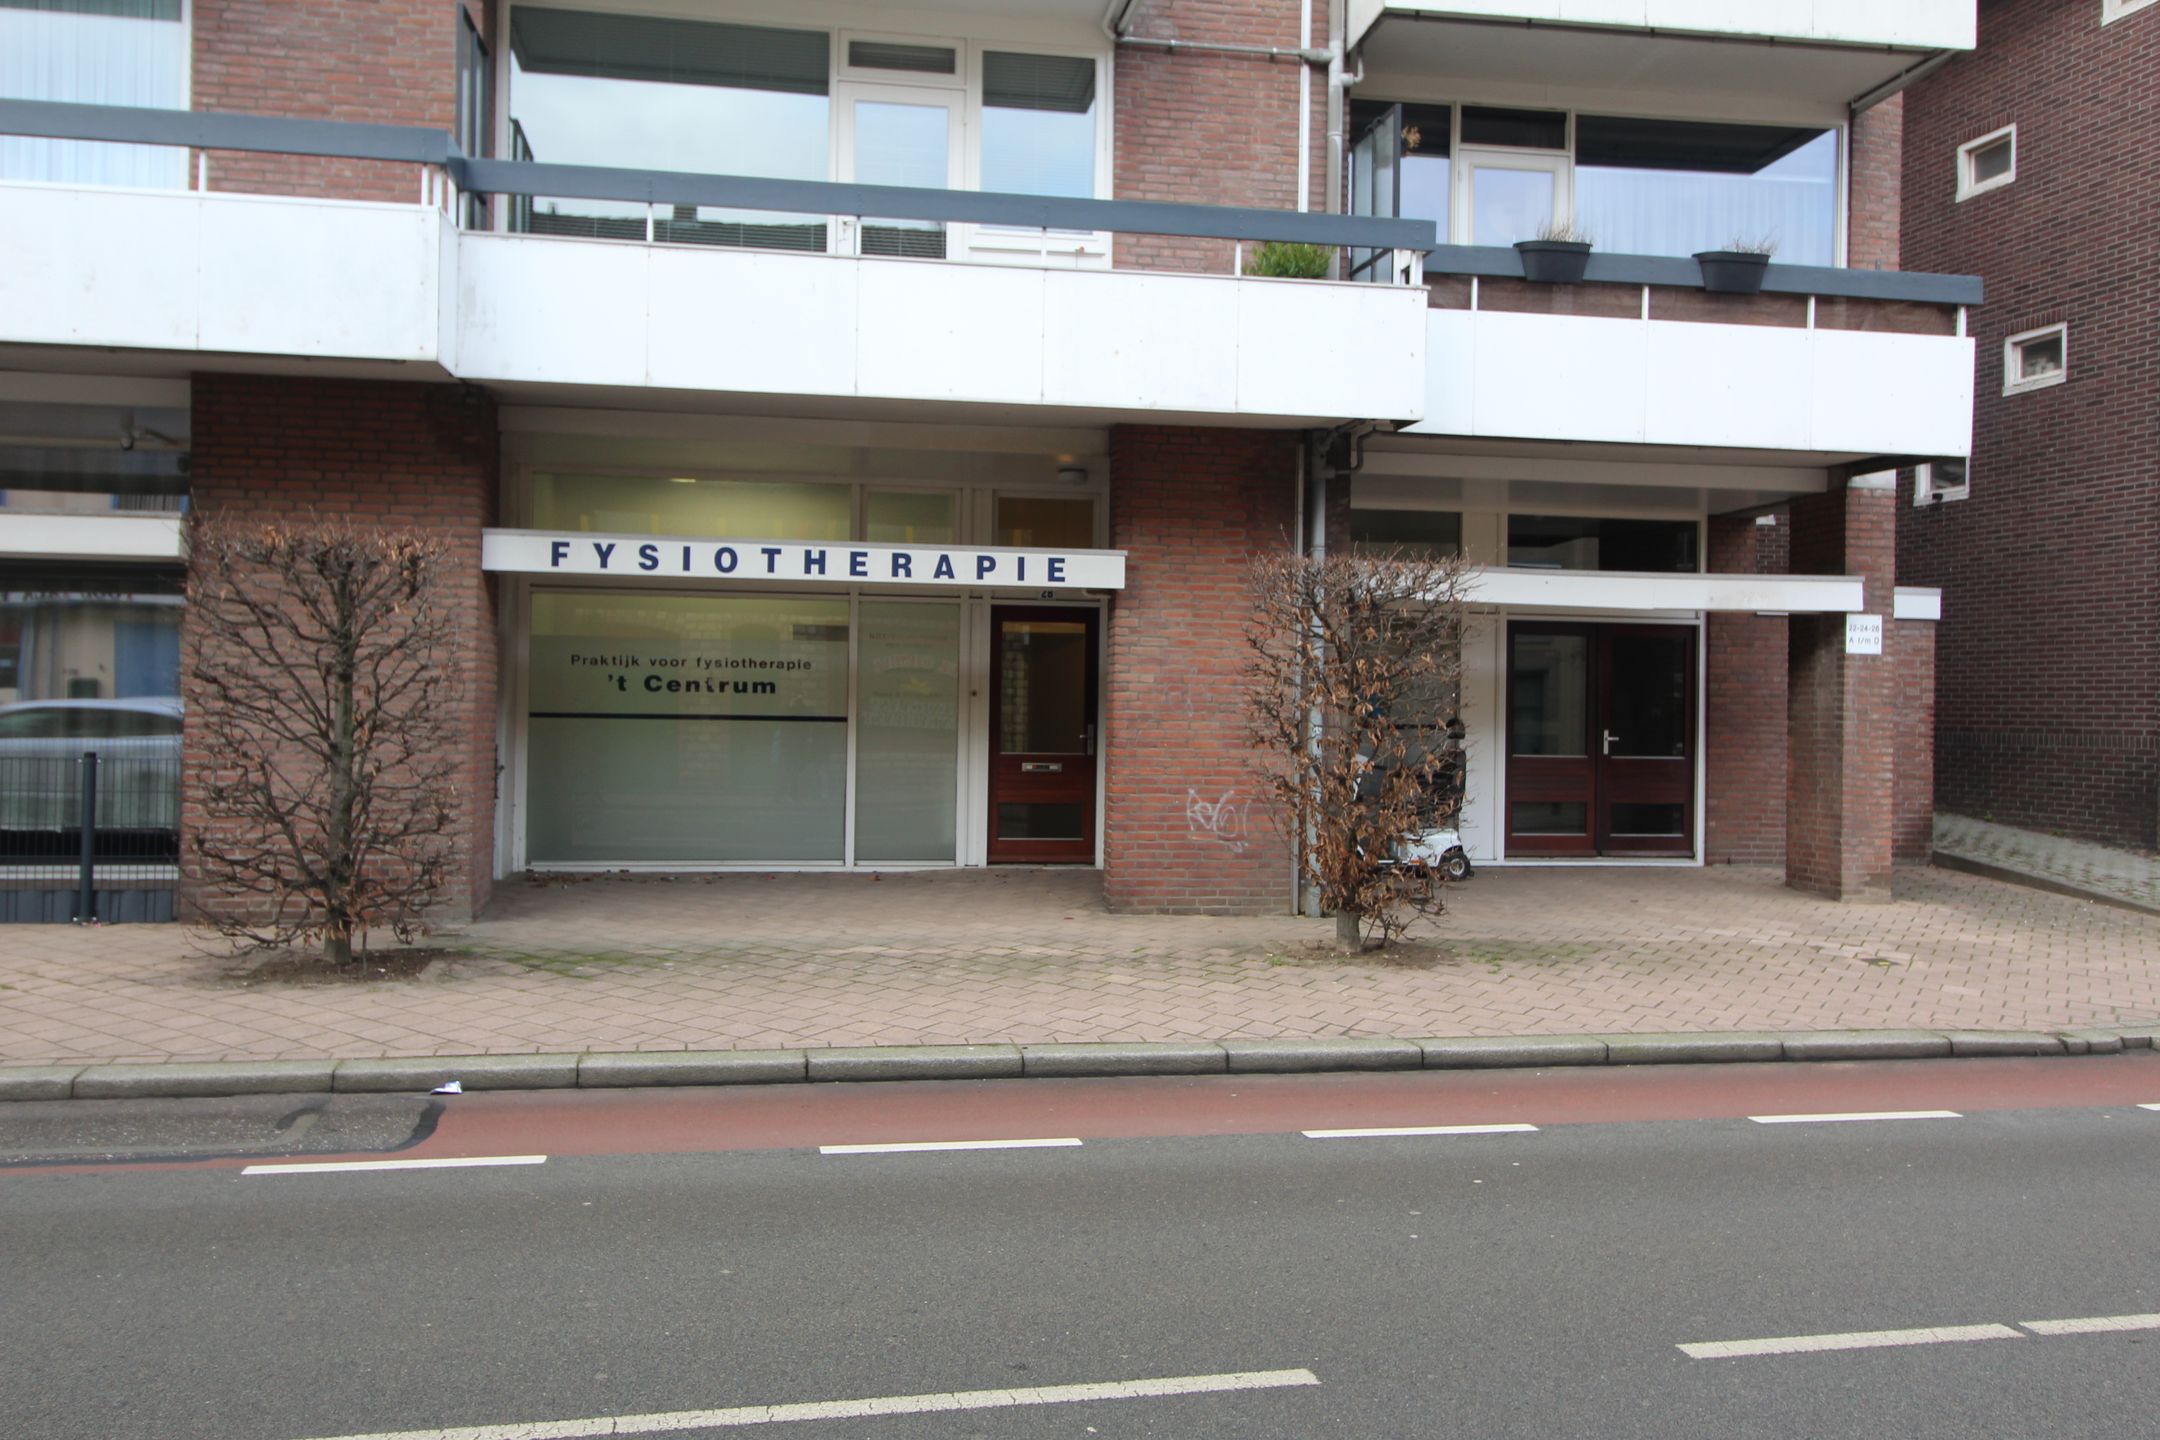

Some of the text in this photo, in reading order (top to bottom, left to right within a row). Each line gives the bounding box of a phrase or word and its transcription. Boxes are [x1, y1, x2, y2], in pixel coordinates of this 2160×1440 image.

[550, 541, 1067, 583] FYSIOTHERAPIE
[570, 654, 812, 671] Praktijk voor fysiotherapie
[643, 674, 777, 694] Centrum
